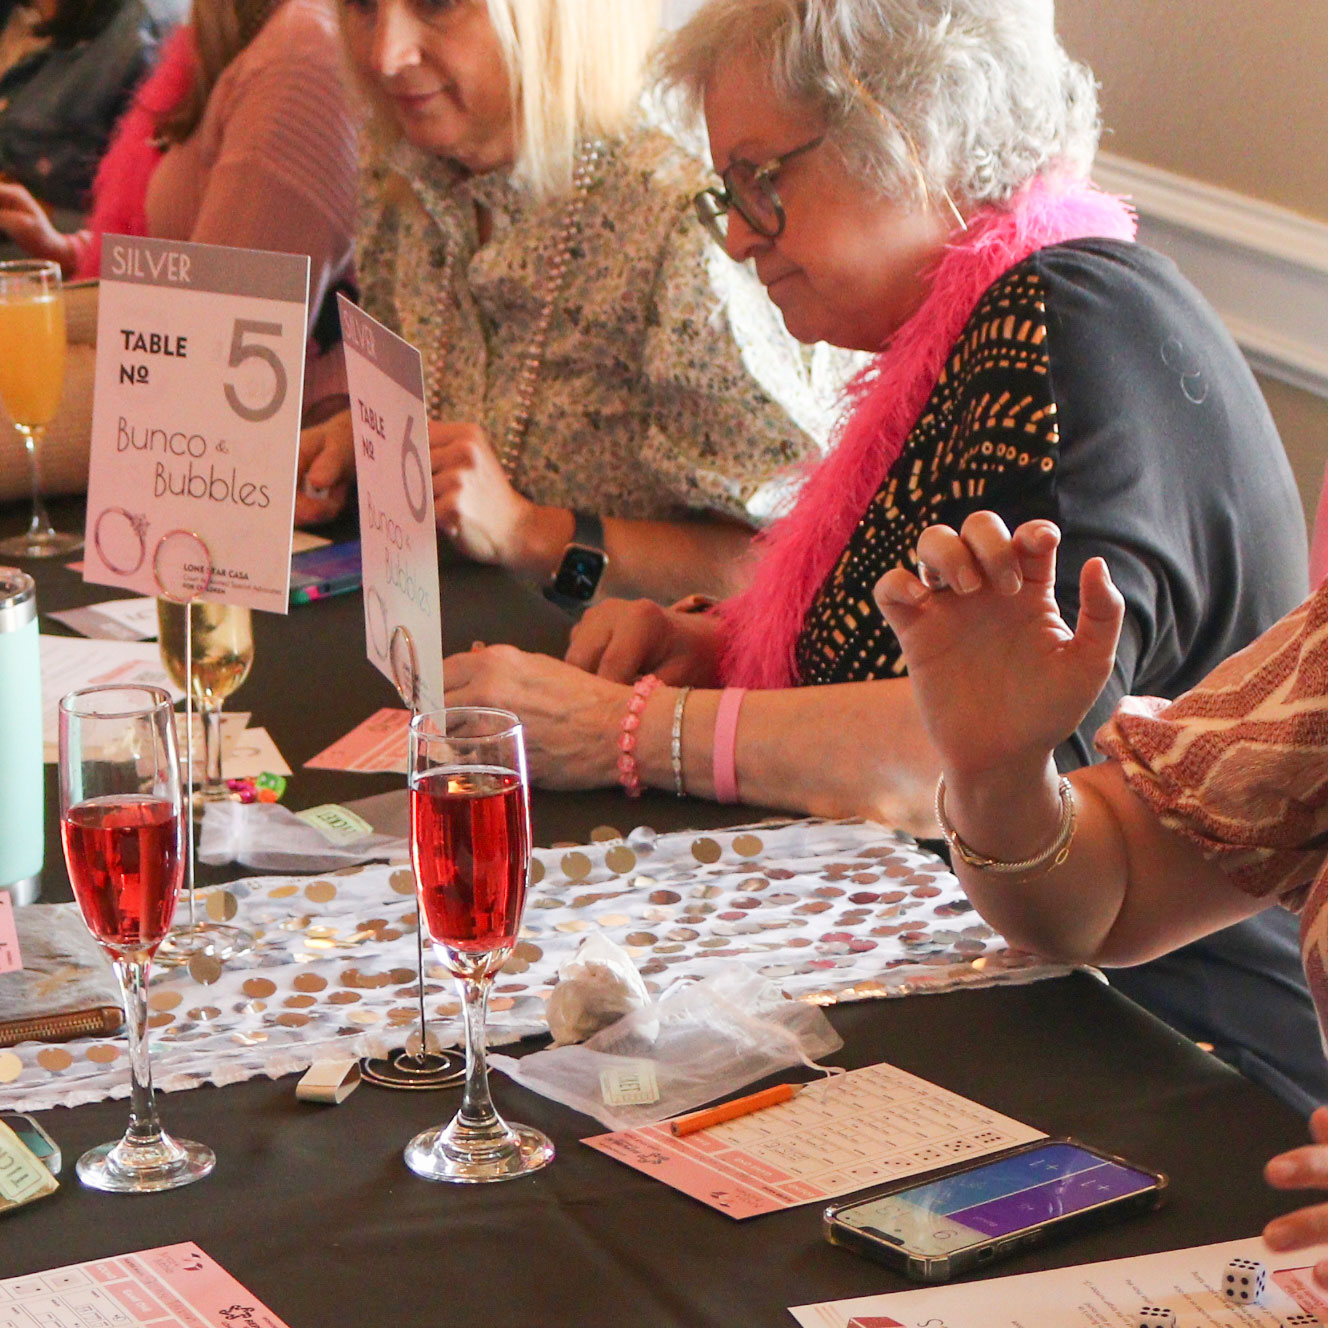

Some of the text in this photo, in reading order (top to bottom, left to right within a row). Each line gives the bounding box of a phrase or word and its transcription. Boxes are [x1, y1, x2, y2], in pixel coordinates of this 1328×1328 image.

[112, 246, 190, 281] SILVER
[121, 329, 186, 357] TABLE
[224, 319, 286, 421] 5
[116, 416, 229, 458] Bunco &
[358, 399, 385, 439] TABLE
[154, 461, 269, 507] Bubbles
[400, 415, 427, 522] 6
[366, 488, 403, 553] Bunco
[1025, 1158, 1064, 1173] +1
